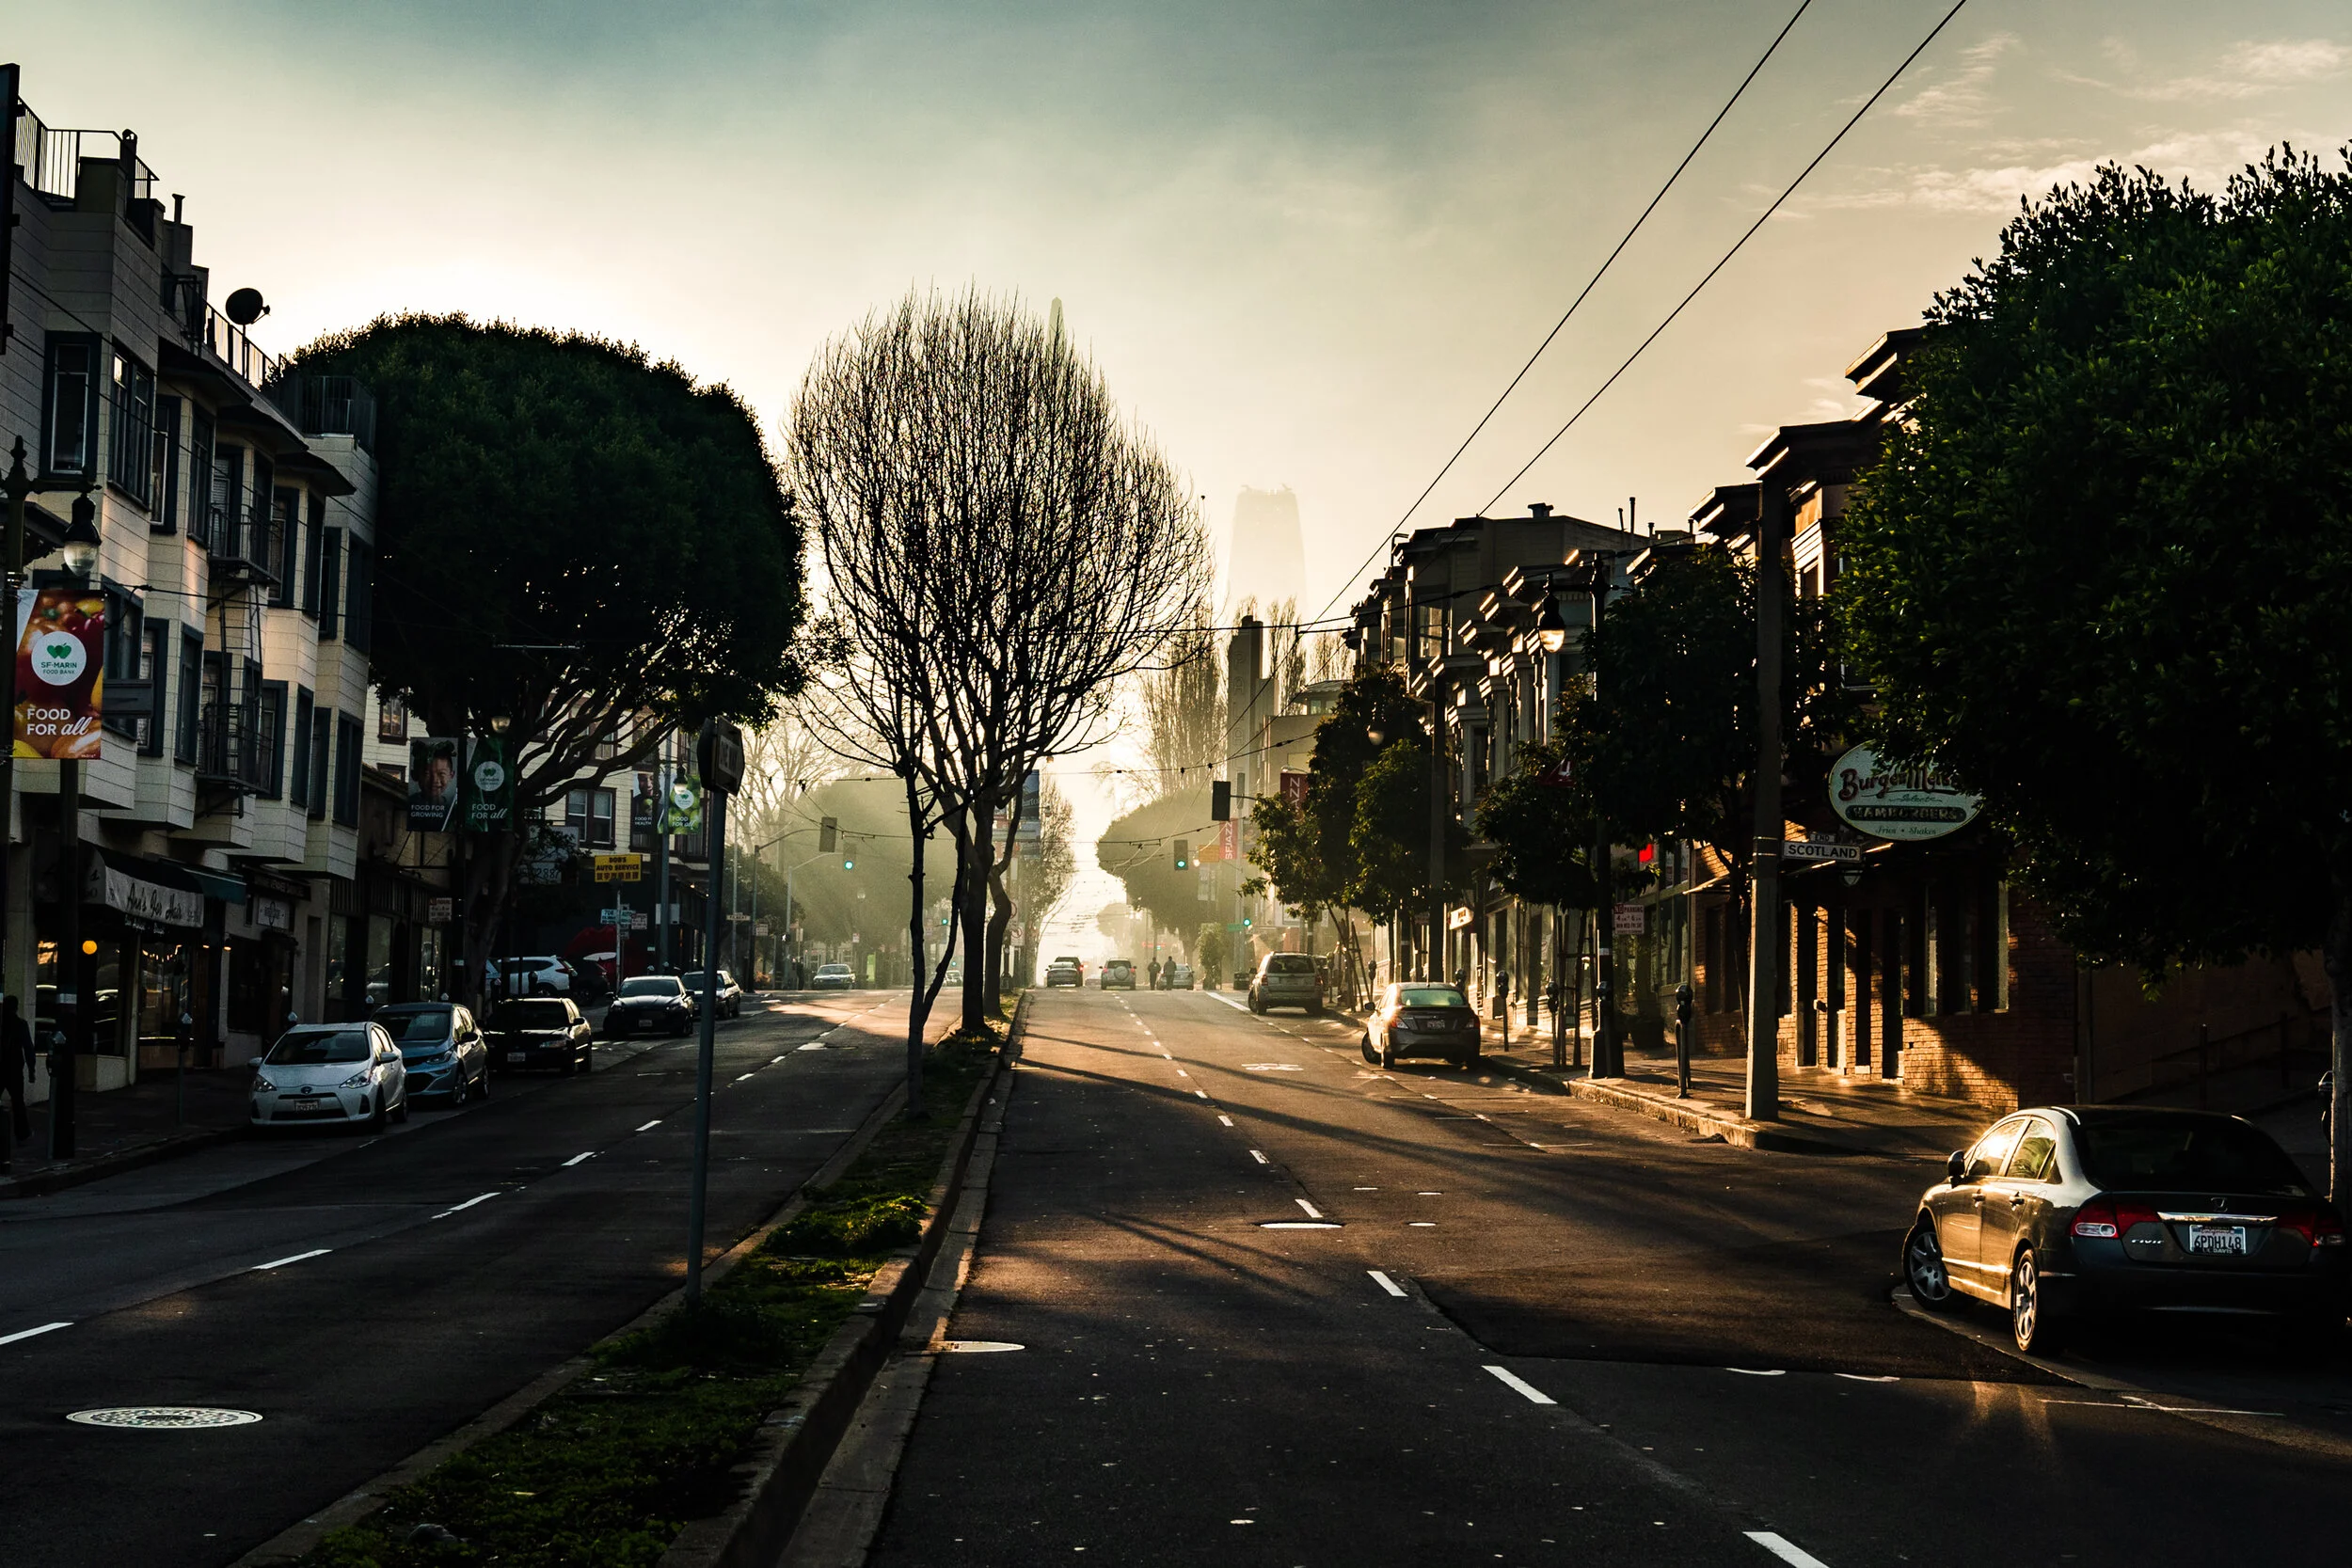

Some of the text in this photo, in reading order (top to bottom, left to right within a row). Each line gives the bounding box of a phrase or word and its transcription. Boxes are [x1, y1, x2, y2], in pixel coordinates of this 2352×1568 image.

[26, 708, 71, 721] FOOD
[26, 716, 93, 736] FOR all
[1290, 777, 1299, 810] AZZ
[490, 808, 508, 819] all
[1852, 807, 1958, 820] HAMBURGERS
[1788, 845, 1857, 858] SCOTLAND
[2194, 1235, 2242, 1249] 6PDH148
